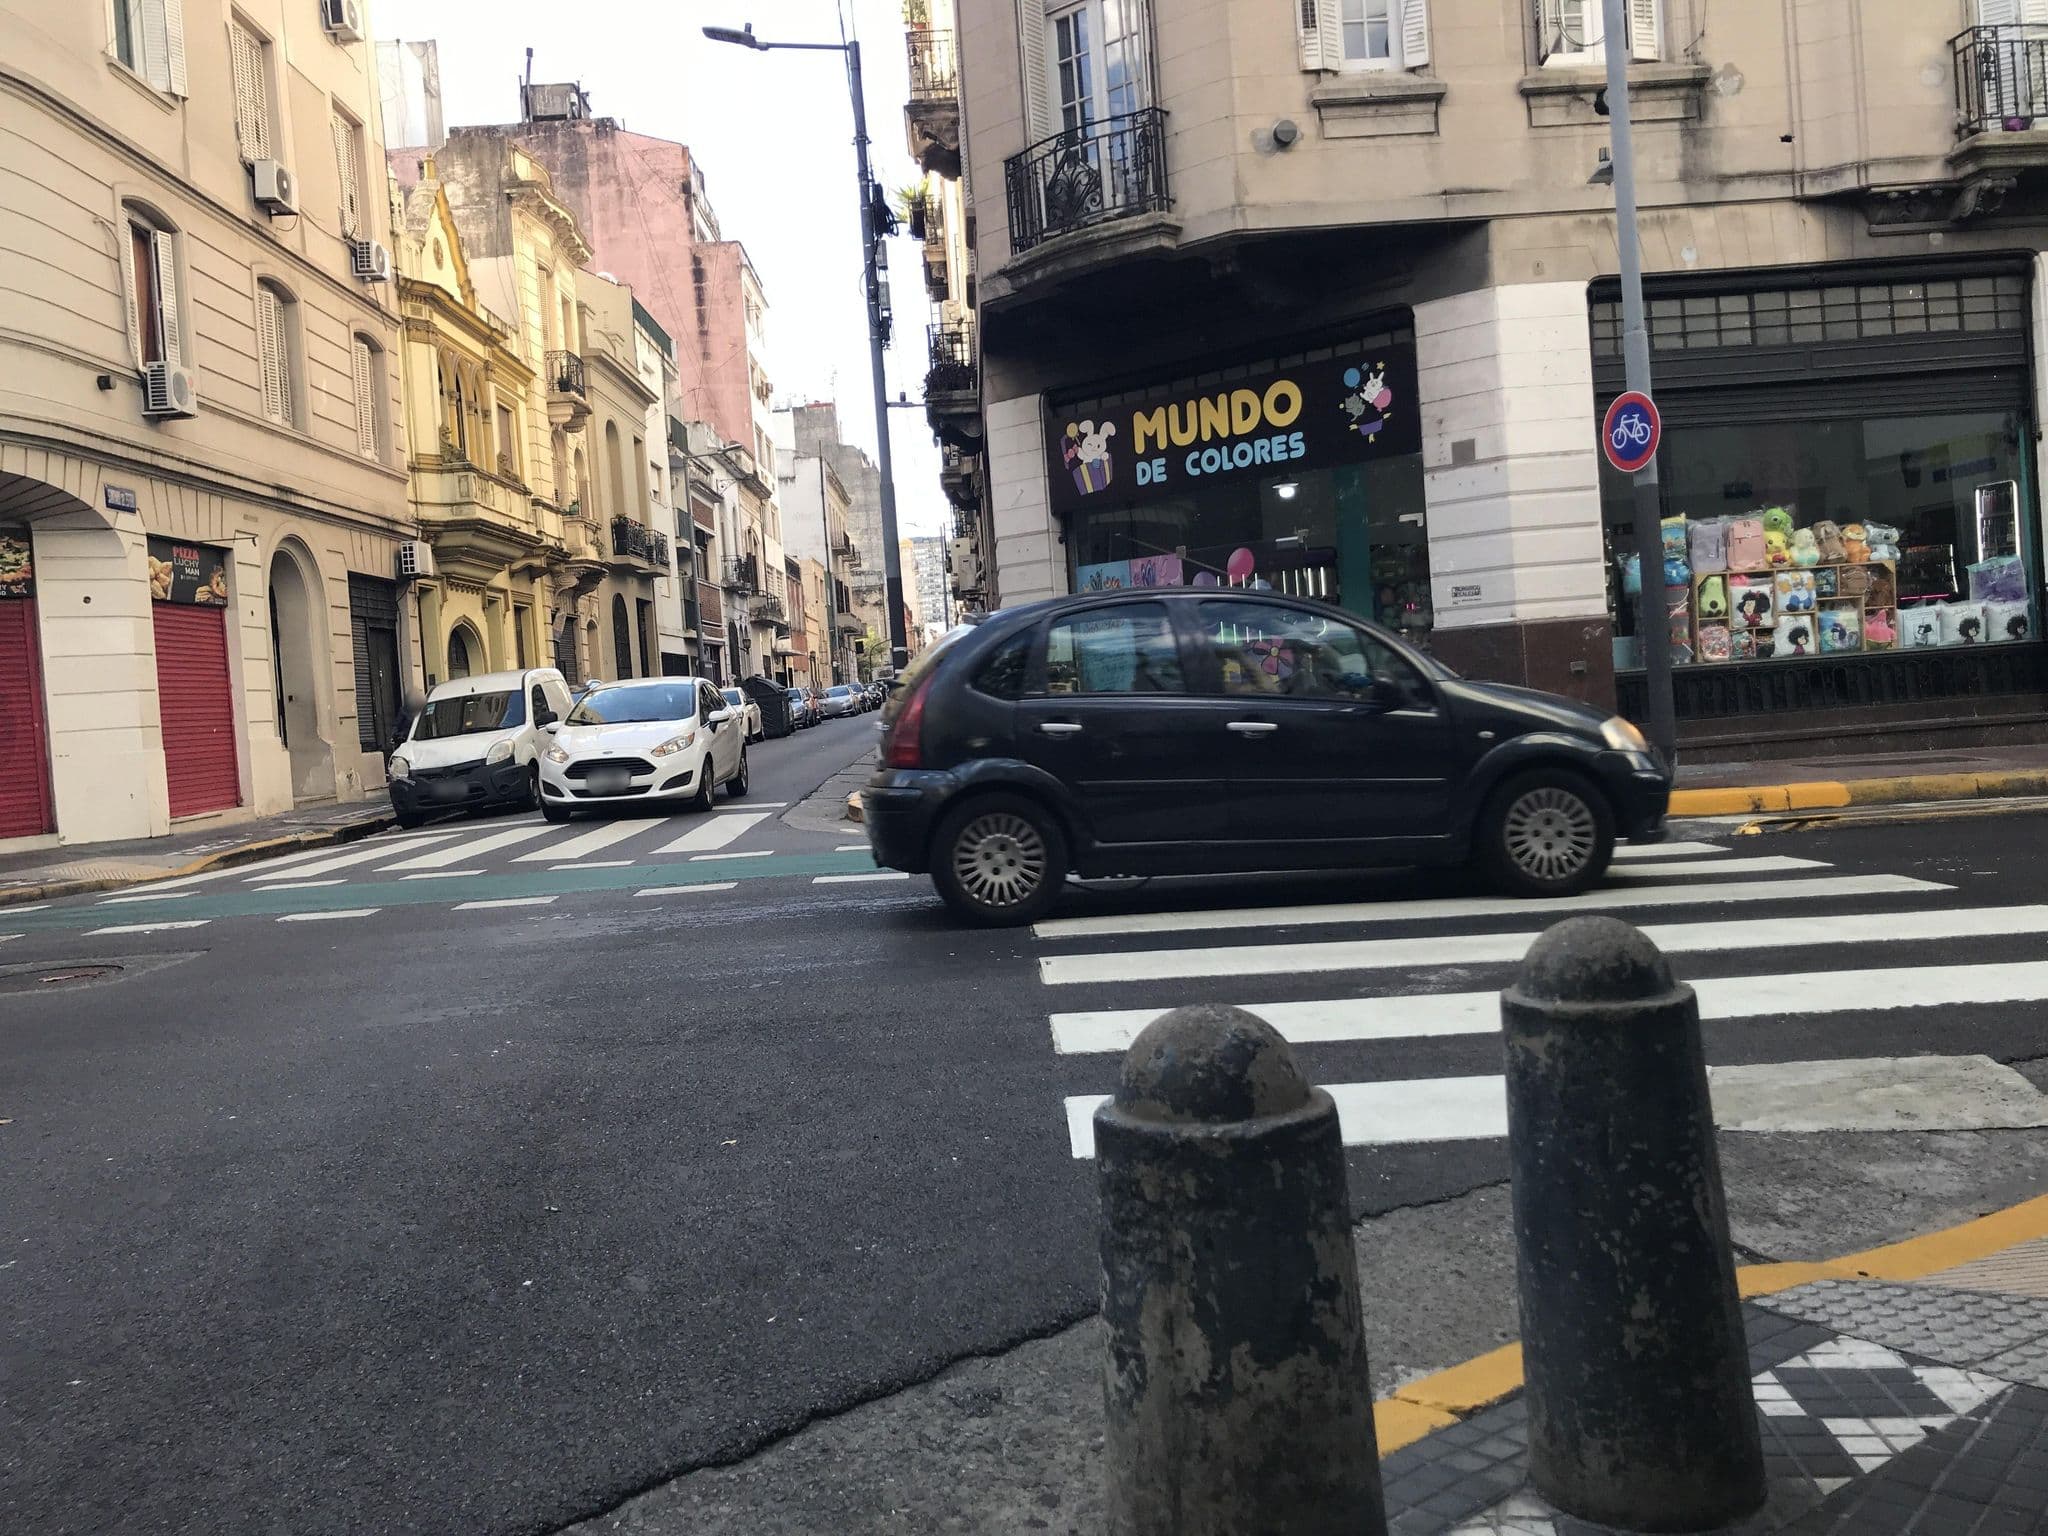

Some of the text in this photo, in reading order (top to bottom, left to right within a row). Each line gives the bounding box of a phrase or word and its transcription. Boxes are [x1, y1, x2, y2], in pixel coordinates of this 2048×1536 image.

[1133, 379, 1302, 454] MUNDO
[1136, 431, 1306, 486] DE COLORES
[173, 546, 200, 560] PIZZA
[185, 567, 200, 577] MAN
